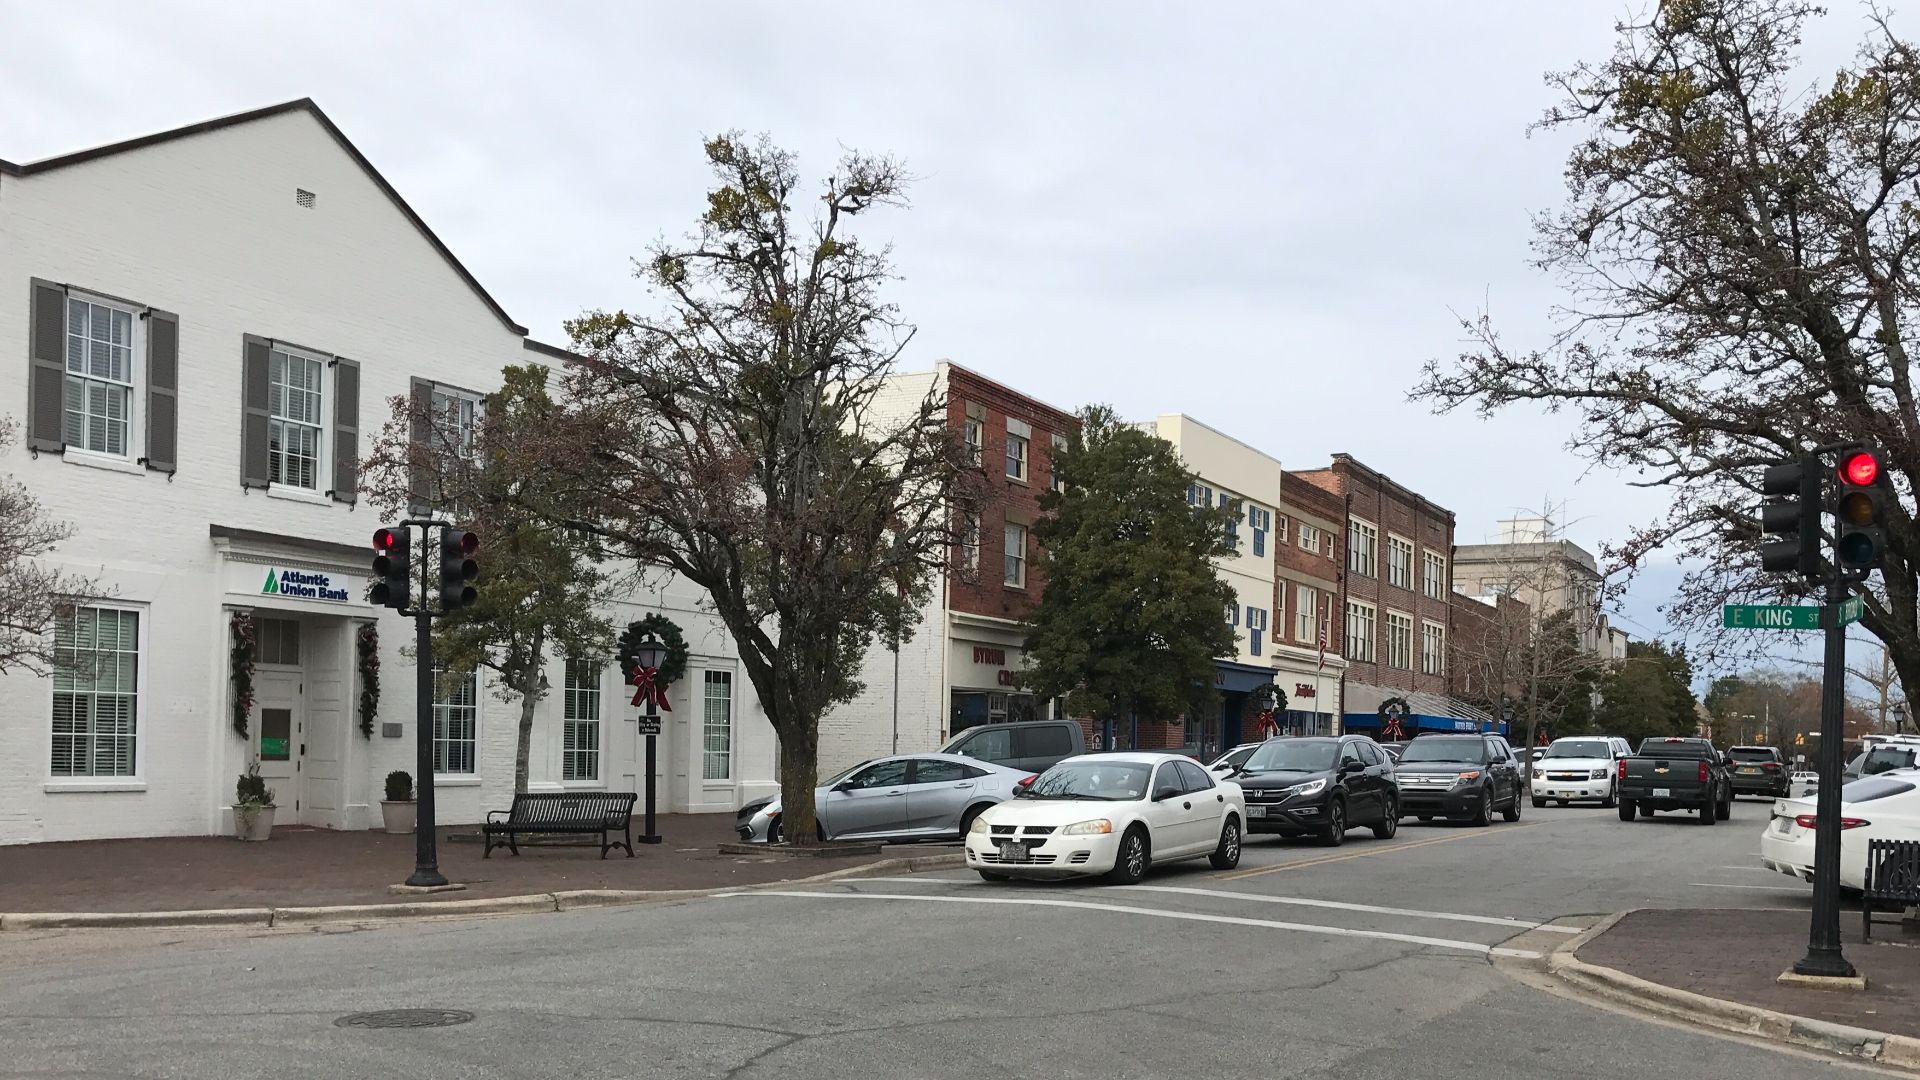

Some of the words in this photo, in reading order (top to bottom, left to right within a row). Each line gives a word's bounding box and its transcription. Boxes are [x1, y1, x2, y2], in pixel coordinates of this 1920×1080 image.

[281, 570, 329, 587] Atlantic
[280, 583, 316, 598] Union
[319, 587, 349, 601] Bank
[1733, 608, 1743, 625] E
[1755, 609, 1793, 626] KING
[1808, 613, 1819, 623] ST
